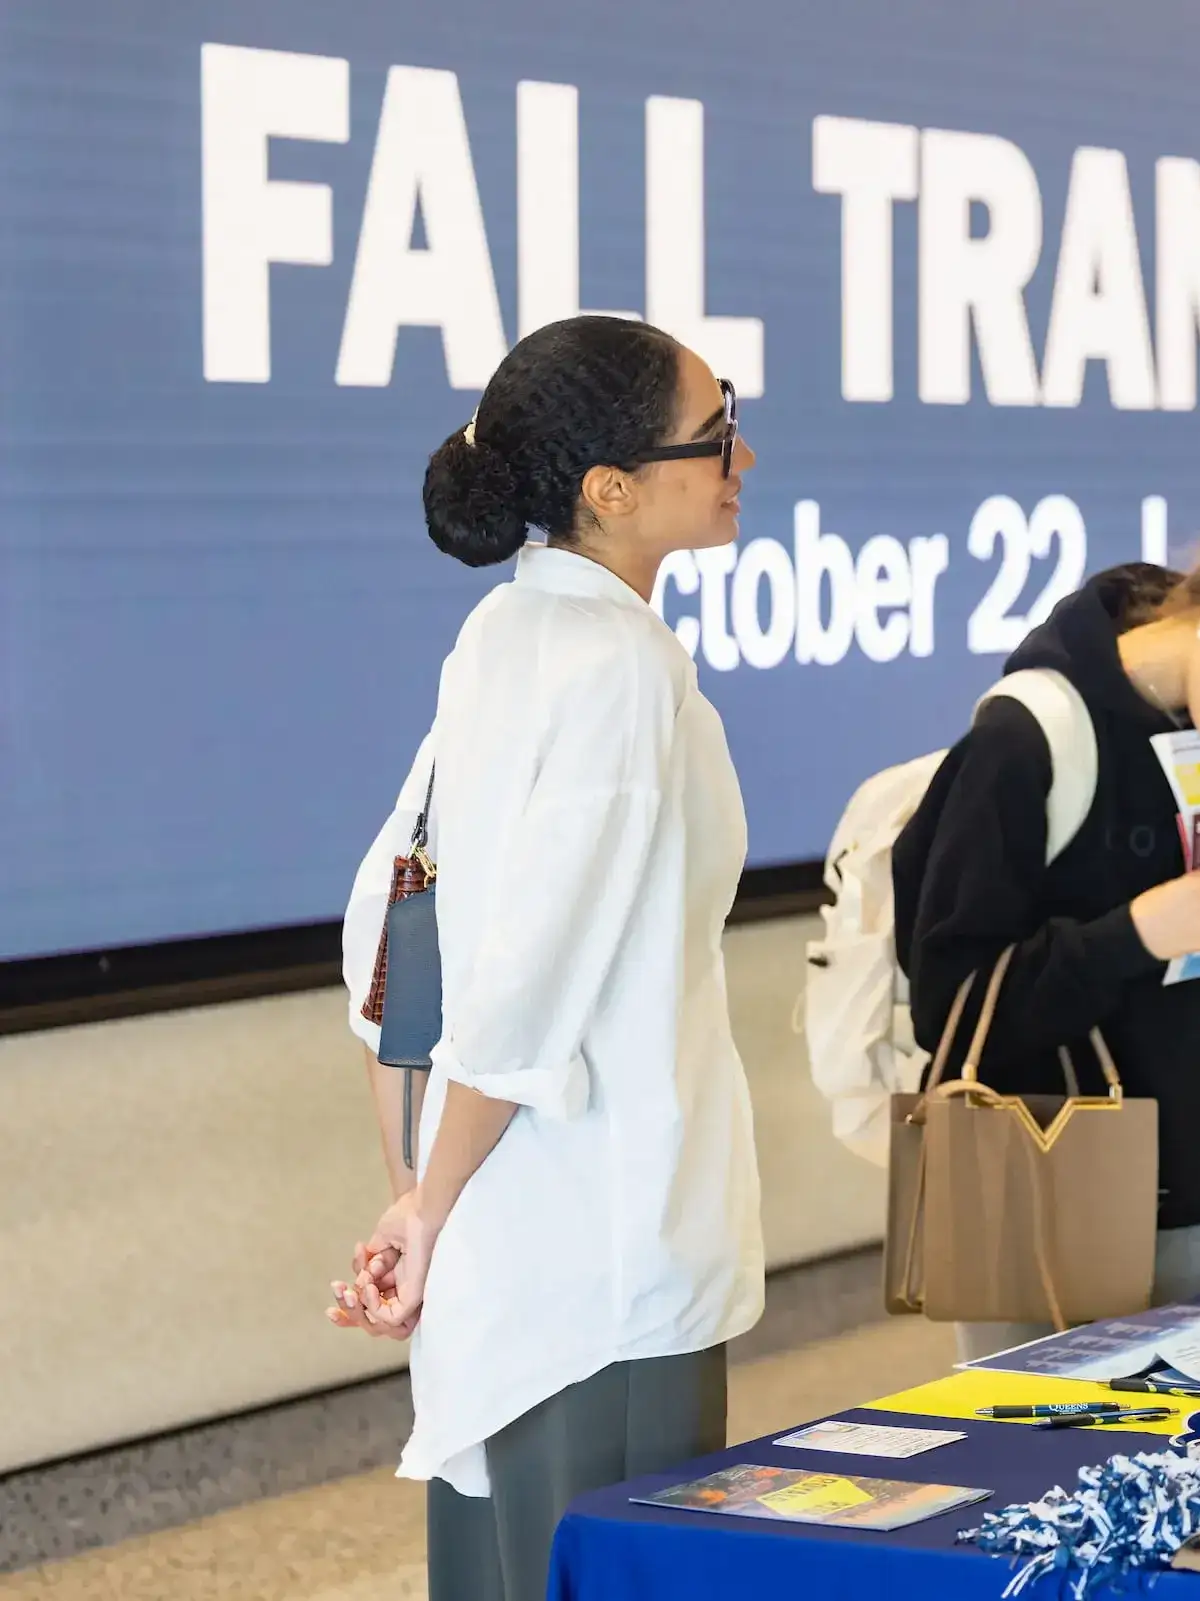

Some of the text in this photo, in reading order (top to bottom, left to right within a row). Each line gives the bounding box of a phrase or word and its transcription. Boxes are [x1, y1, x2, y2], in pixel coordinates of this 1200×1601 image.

[201, 43, 764, 398] FALL
[650, 499, 949, 671] ctober
[967, 495, 1086, 654] 22
[1048, 1402, 1089, 1413] QUEENS
